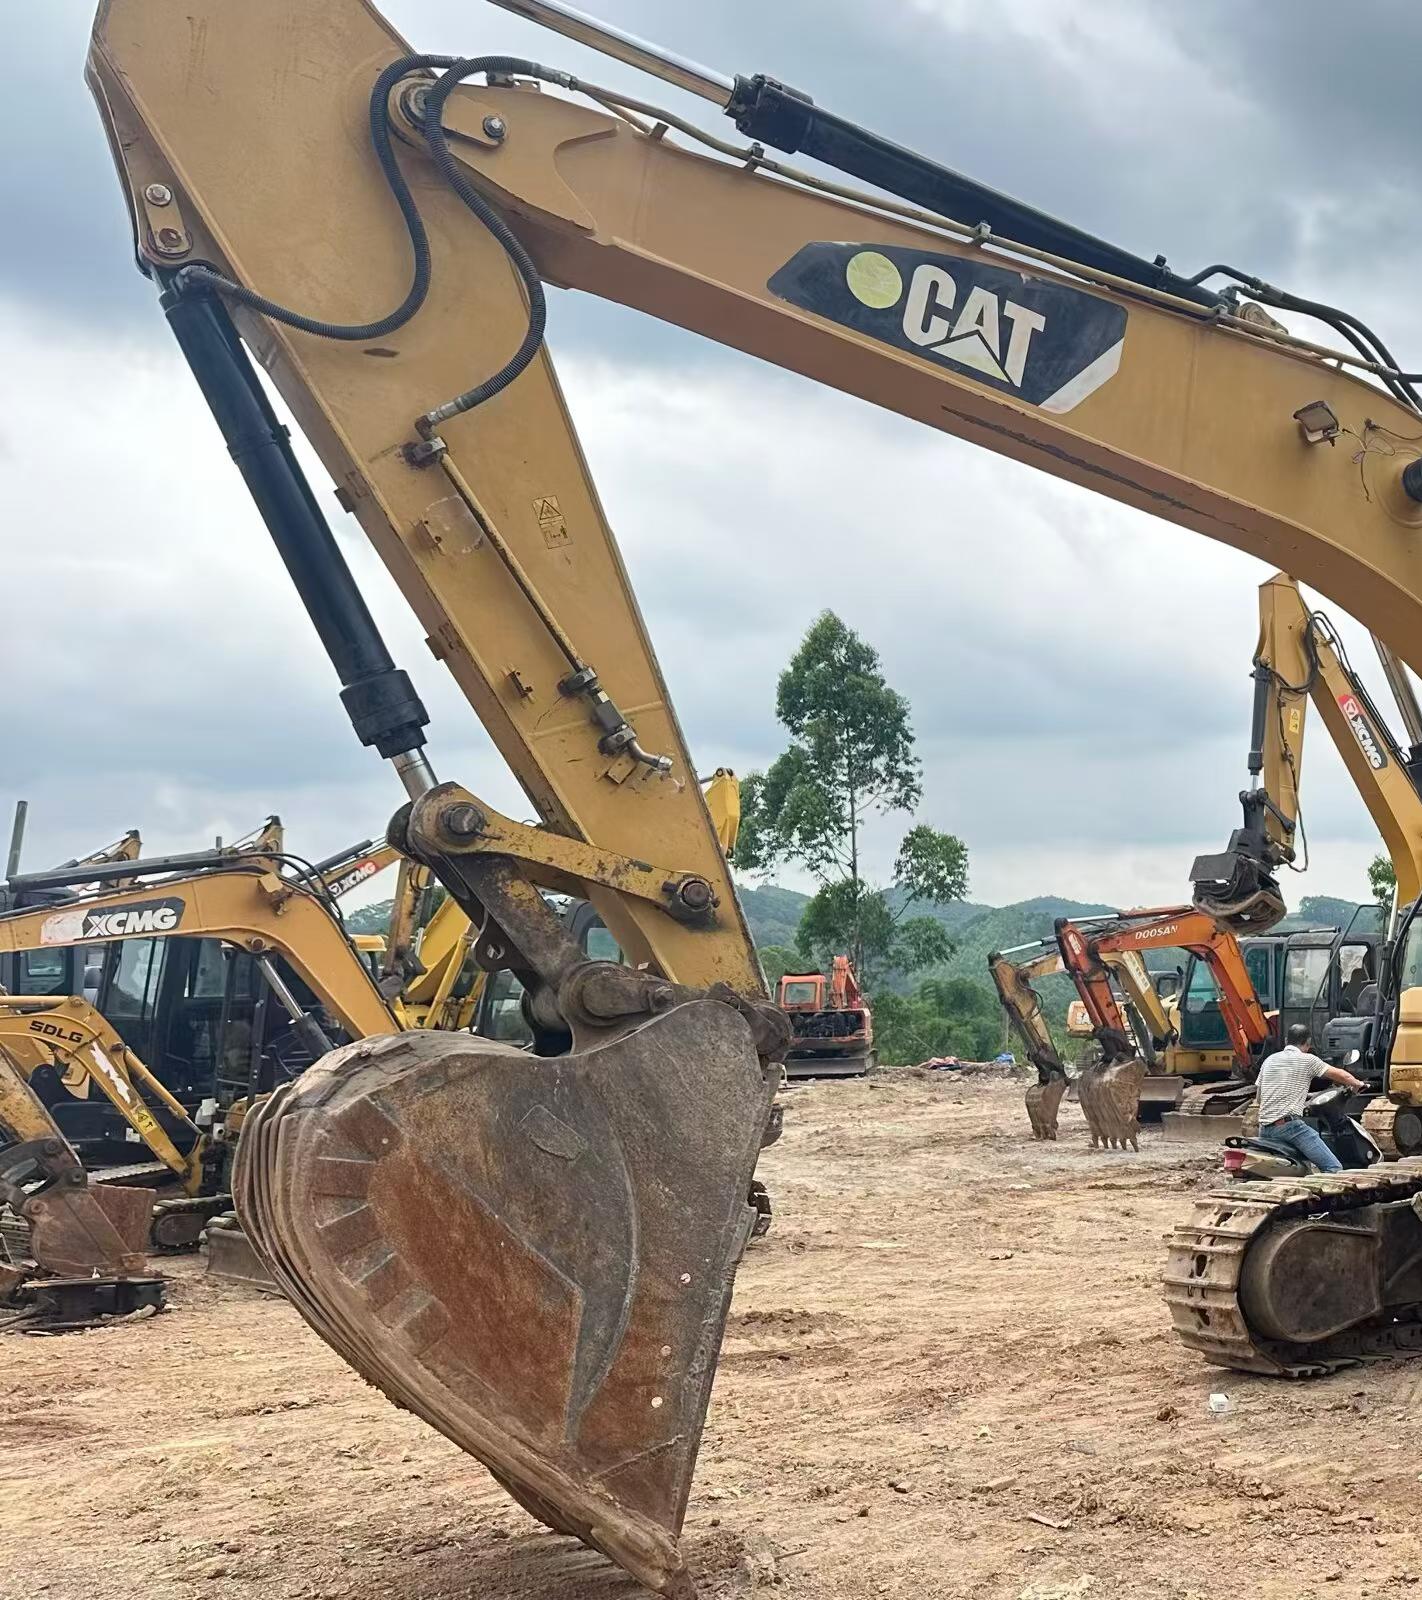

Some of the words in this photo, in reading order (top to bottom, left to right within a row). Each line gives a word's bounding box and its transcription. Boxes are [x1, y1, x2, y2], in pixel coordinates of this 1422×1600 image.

[903, 264, 1046, 387] CAT
[1351, 716, 1382, 769] XCMG
[340, 861, 377, 891] XCMG
[83, 907, 177, 938] XCMG
[1135, 925, 1178, 940] DOOSAN
[30, 1020, 84, 1043] SDLG
